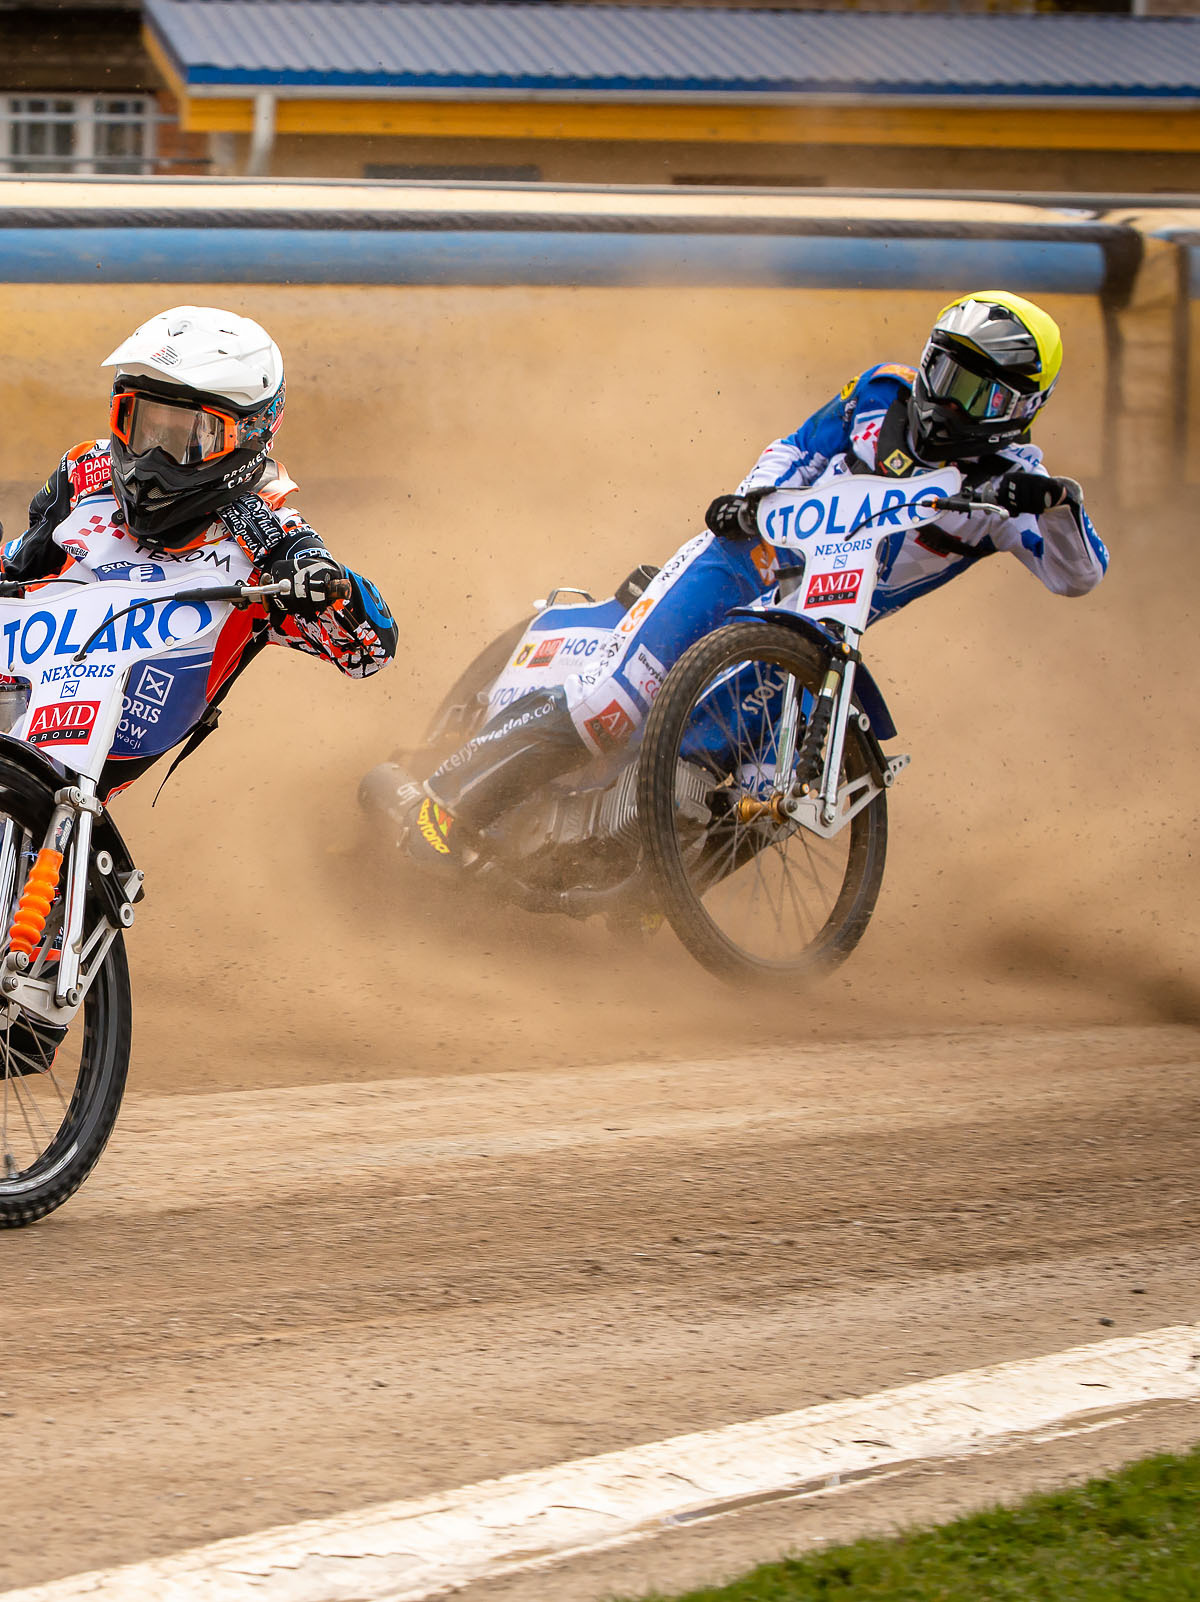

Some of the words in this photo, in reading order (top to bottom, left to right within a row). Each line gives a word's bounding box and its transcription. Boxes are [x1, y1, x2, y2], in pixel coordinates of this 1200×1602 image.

[815, 538, 873, 557] NEXORIS
[101, 560, 132, 574] STAL
[809, 571, 861, 595] AMD
[808, 591, 856, 604] GROUP
[41, 664, 116, 685] NEXORIS
[741, 670, 789, 716] STOLA
[30, 703, 96, 733] AMD
[121, 696, 162, 725] ORIS
[29, 730, 87, 744] GROUP
[115, 732, 142, 751] wacji
